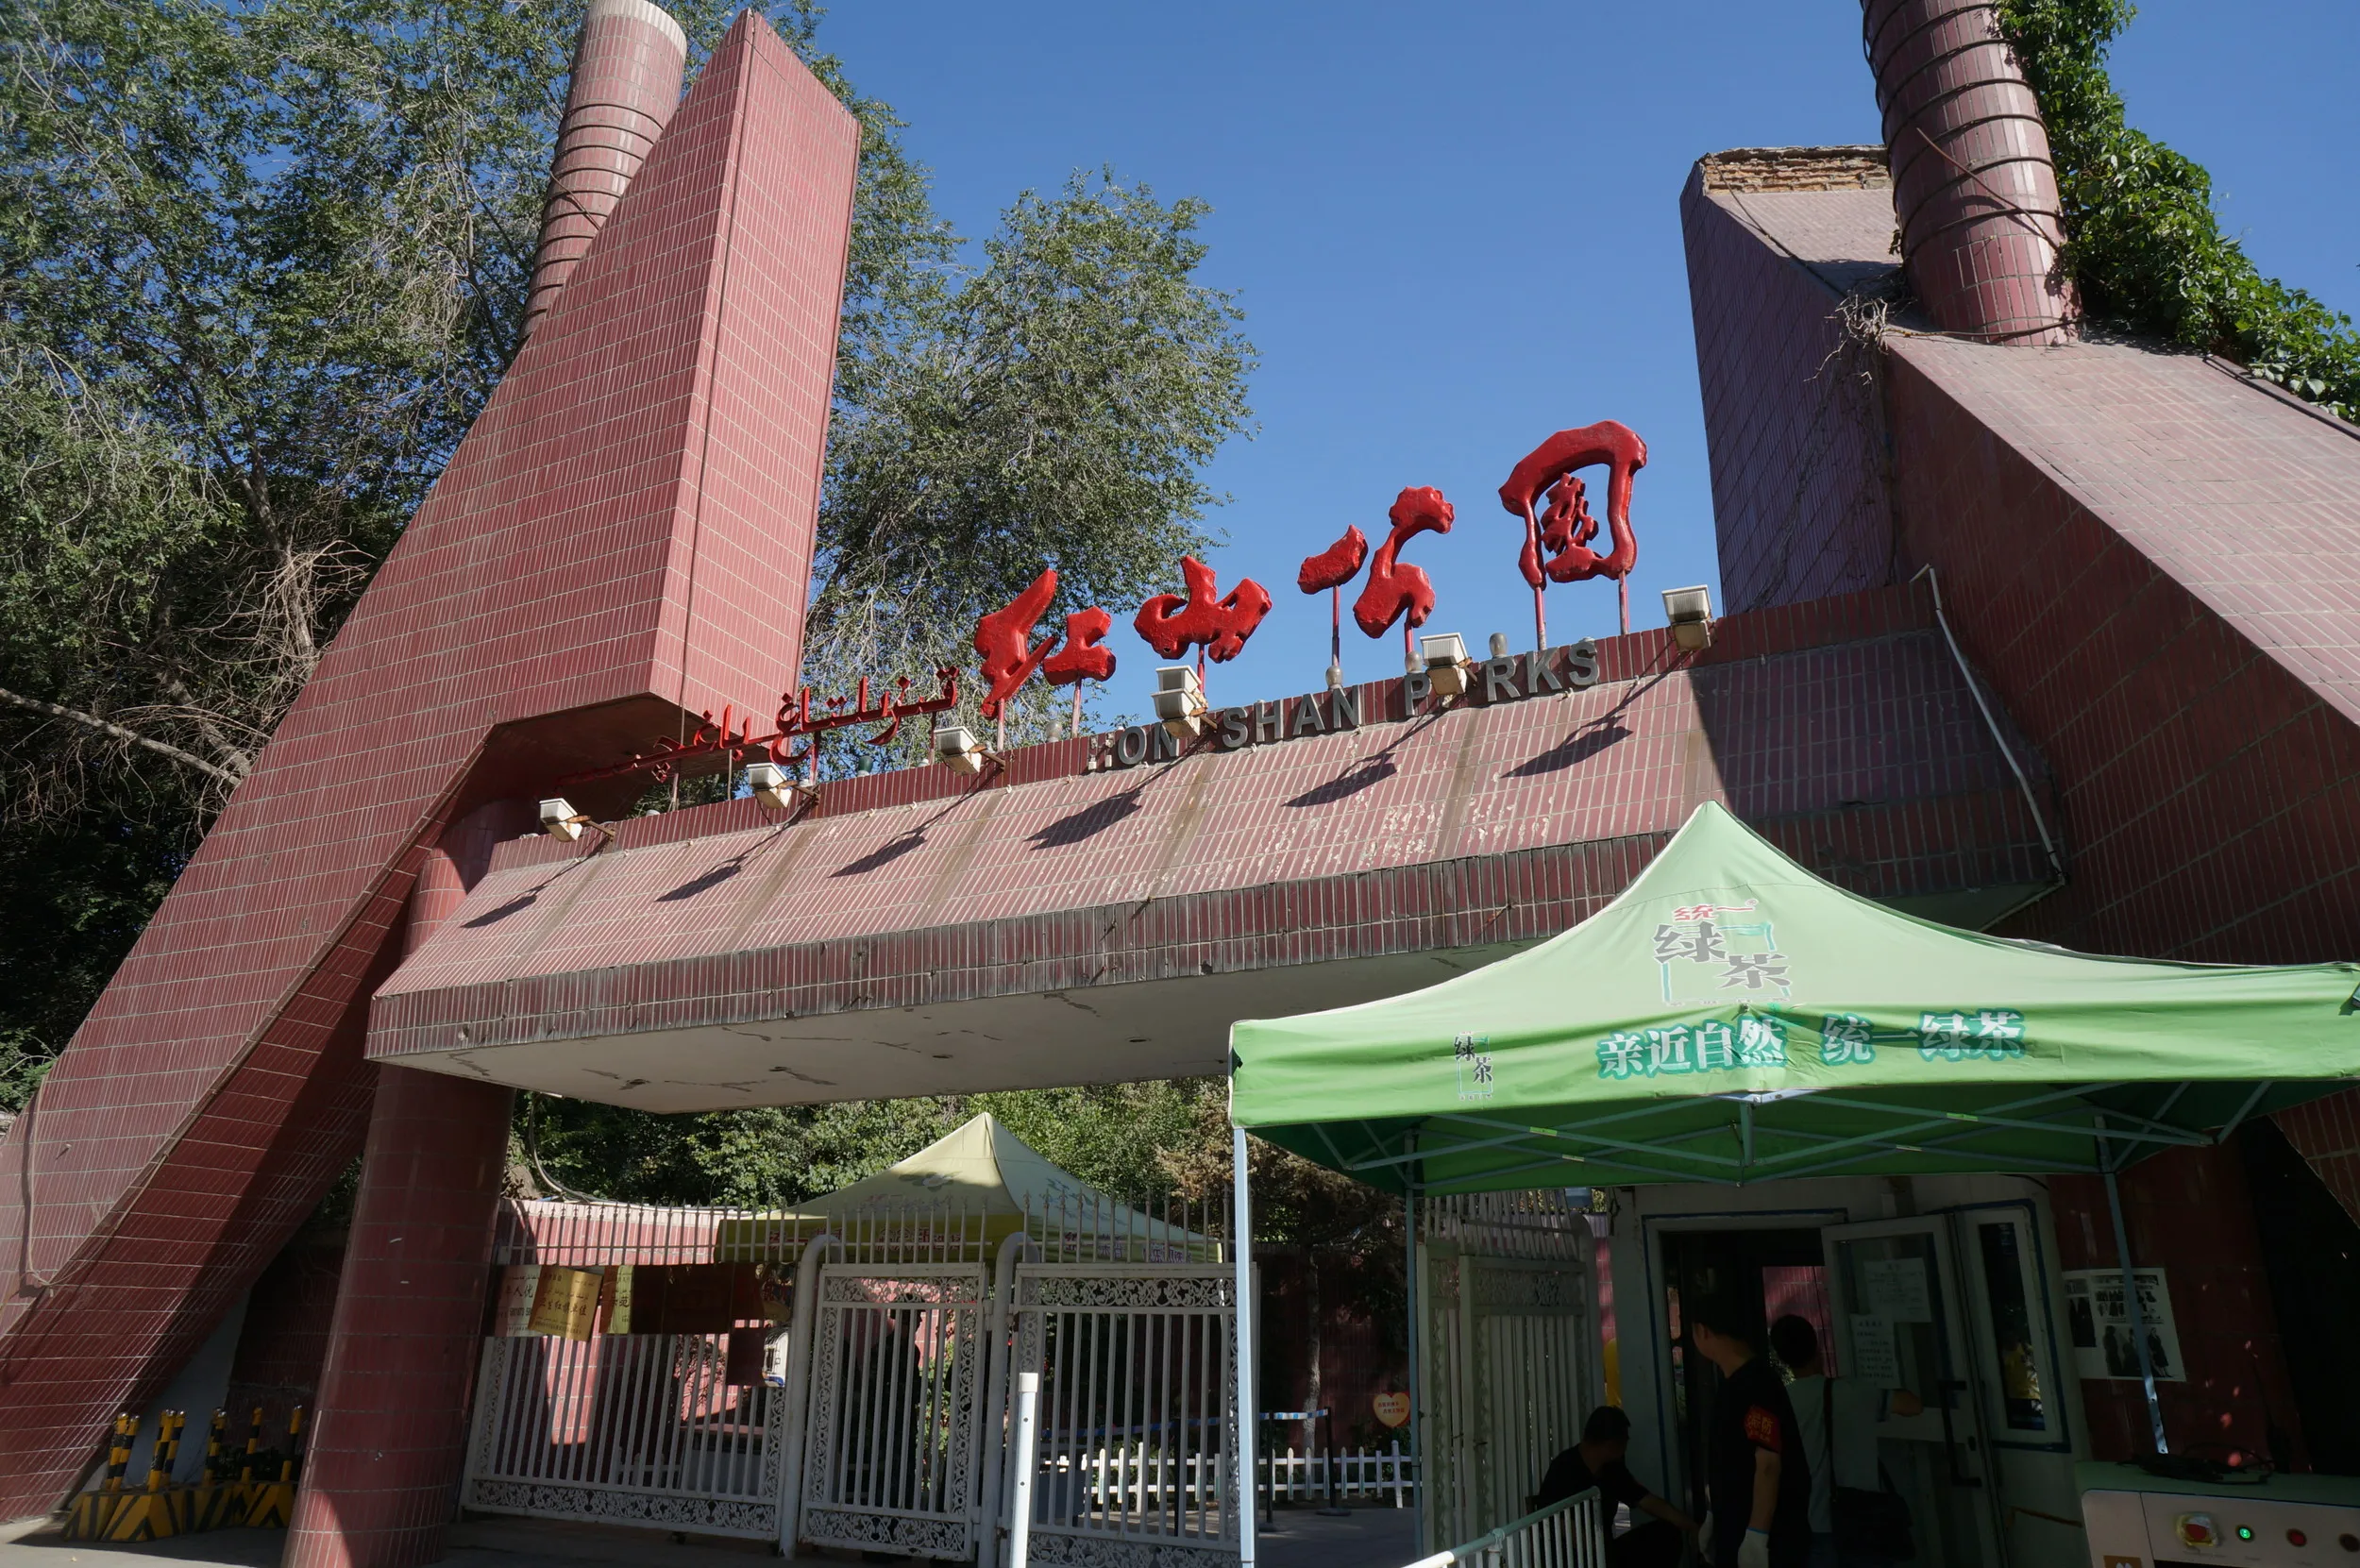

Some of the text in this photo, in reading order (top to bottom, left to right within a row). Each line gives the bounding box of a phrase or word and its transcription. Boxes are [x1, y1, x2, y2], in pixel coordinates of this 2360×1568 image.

[1222, 684, 1362, 748] SHAN
[1404, 639, 1601, 716] PRKS
[1672, 903, 1754, 922] 统一
[1652, 920, 1793, 991] 绿茶
[1454, 1036, 1493, 1085] 绿茶
[1599, 1010, 2023, 1076] 亲近自然 统一绿茶
